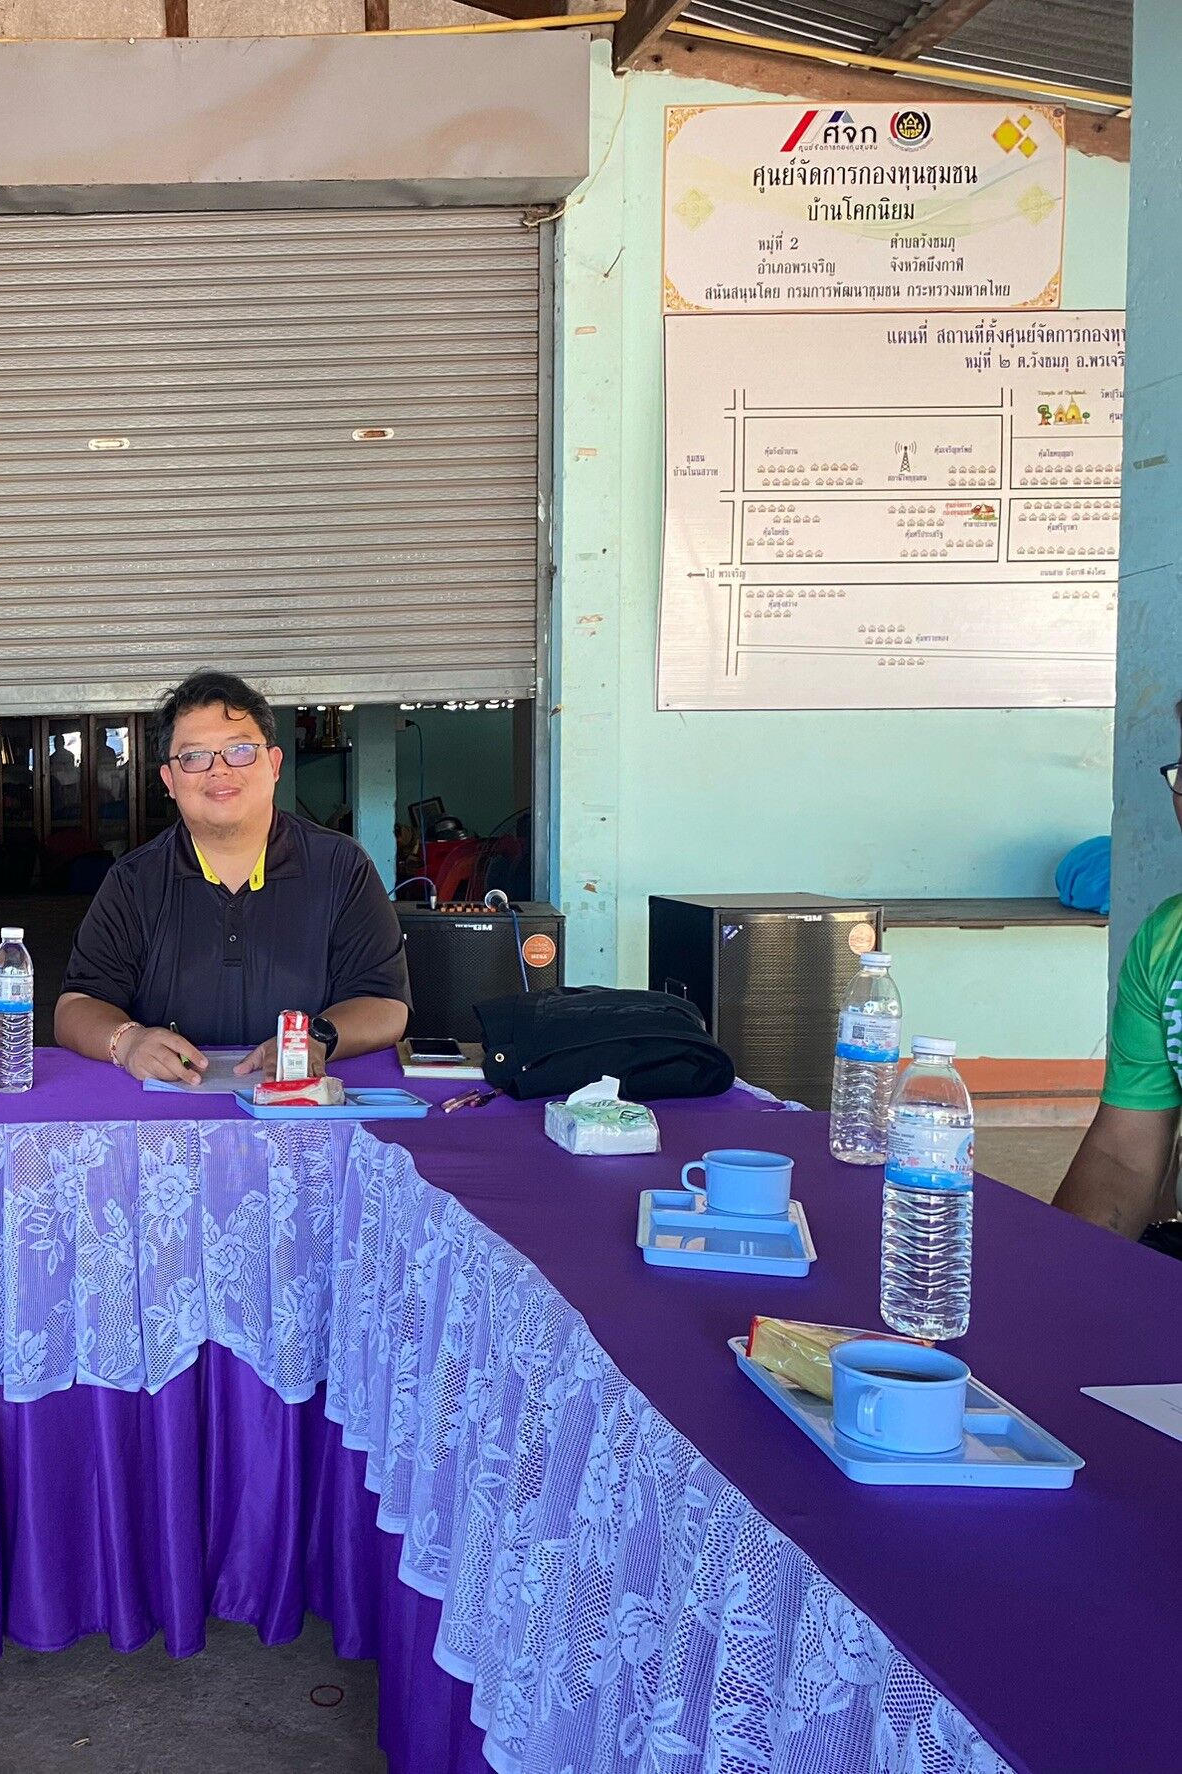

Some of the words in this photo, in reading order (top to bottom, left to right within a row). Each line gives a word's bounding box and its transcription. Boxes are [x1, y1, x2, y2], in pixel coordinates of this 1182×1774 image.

[752, 158, 978, 194] ศูนย์จัดการกองทุนชุมชน
[807, 196, 915, 222] บ้านโคกนิยม
[758, 230, 784, 253] หมู่ที่
[790, 237, 799, 251] 2
[890, 233, 956, 253] ตำบลวังชมภู
[757, 258, 836, 276] อำเภอพรเจริญ
[890, 255, 964, 273] จังหวัดบึงกาฬ
[787, 280, 901, 301] กรมการพัฒนาชุมชน
[906, 279, 1011, 299] กระทรวงมหาดไทย
[887, 320, 928, 345] แผนที่
[965, 347, 991, 373] หมู่ที่
[999, 354, 1010, 369] ๒
